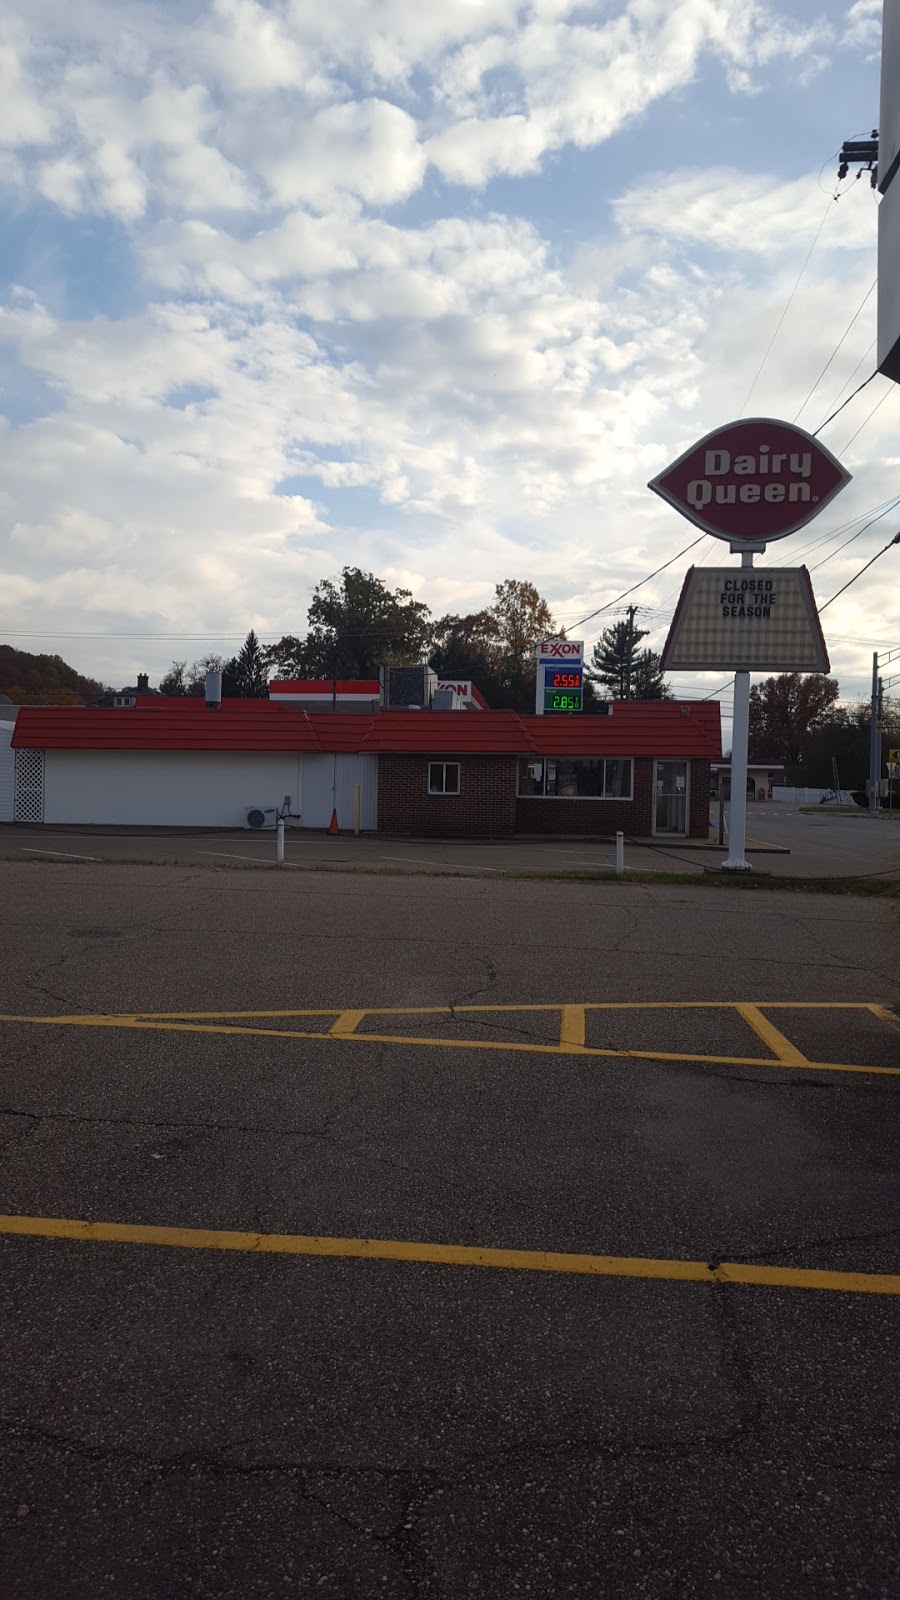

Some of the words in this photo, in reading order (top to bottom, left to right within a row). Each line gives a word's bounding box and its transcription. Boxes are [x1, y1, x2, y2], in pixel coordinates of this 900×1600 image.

[704, 445, 812, 477] Dairy
[687, 480, 811, 510] Queen
[724, 580, 773, 591] CLOSED
[720, 593, 744, 604] FOR
[753, 593, 776, 604] THE
[722, 606, 771, 617] SEASON
[540, 643, 581, 657] EXXON
